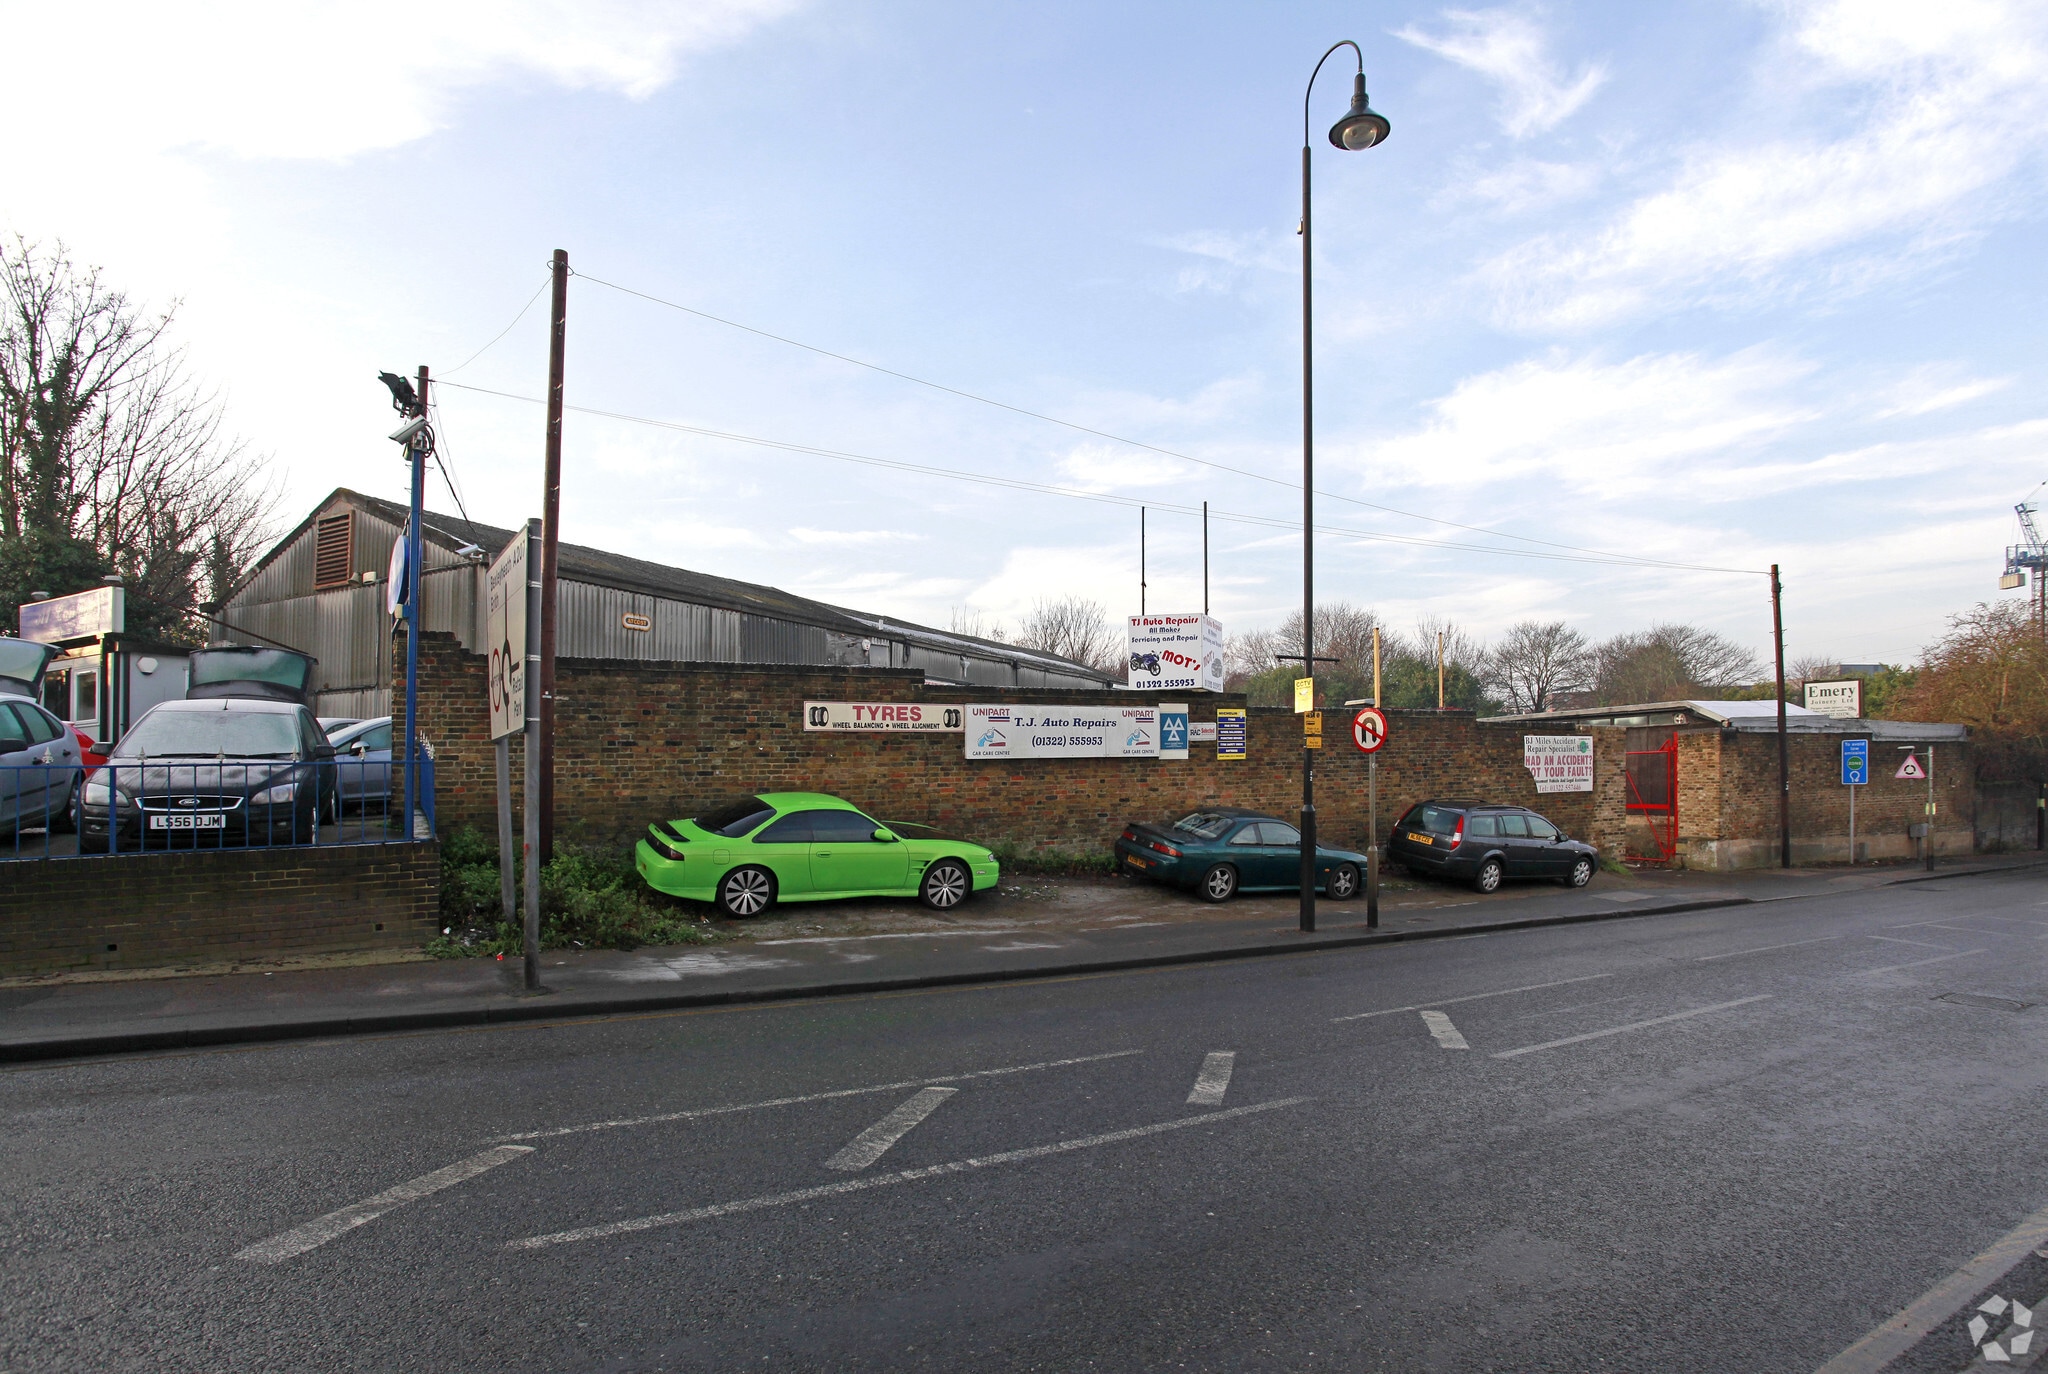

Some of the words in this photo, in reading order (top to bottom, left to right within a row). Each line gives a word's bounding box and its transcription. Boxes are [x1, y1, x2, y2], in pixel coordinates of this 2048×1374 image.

[491, 555, 512, 592] Bexleyheath
[513, 539, 526, 567] A207
[1131, 618, 1140, 626] TJ
[1143, 618, 1163, 626] Auto
[1166, 616, 1198, 626] Repairs
[1131, 636, 1160, 644] Servicing
[1176, 634, 1199, 642] Repair
[1161, 649, 1201, 671] MOT's
[512, 672, 524, 695] Retail
[1136, 680, 1162, 688] 01322
[1164, 679, 1195, 687] 555953
[1296, 680, 1311, 688] CCTV
[1808, 685, 1856, 698] Emery
[513, 698, 522, 718] Park
[852, 705, 922, 722] TYRES
[972, 708, 1010, 716] UNIPART
[1122, 710, 1155, 718] UNIPART
[1014, 718, 1037, 727] T.J.
[1041, 718, 1070, 727] Auto
[1072, 718, 1117, 730] Repairs
[1031, 735, 1067, 748] (01322)
[1069, 736, 1103, 746] 555953
[1525, 737, 1533, 745] BJ
[1535, 737, 1551, 745] Miles
[1552, 737, 1576, 745] Accident
[1527, 745, 1547, 754] Repair
[1548, 745, 1575, 754] Specialist
[1525, 756, 1541, 766] HAD
[1544, 755, 1554, 766] AN
[1557, 755, 1593, 766] ACCIDENT?
[1530, 767, 1541, 777] OT
[1544, 767, 1565, 777] YOUR
[1567, 766, 1593, 777] FAULT?
[156, 816, 191, 828] LS56
